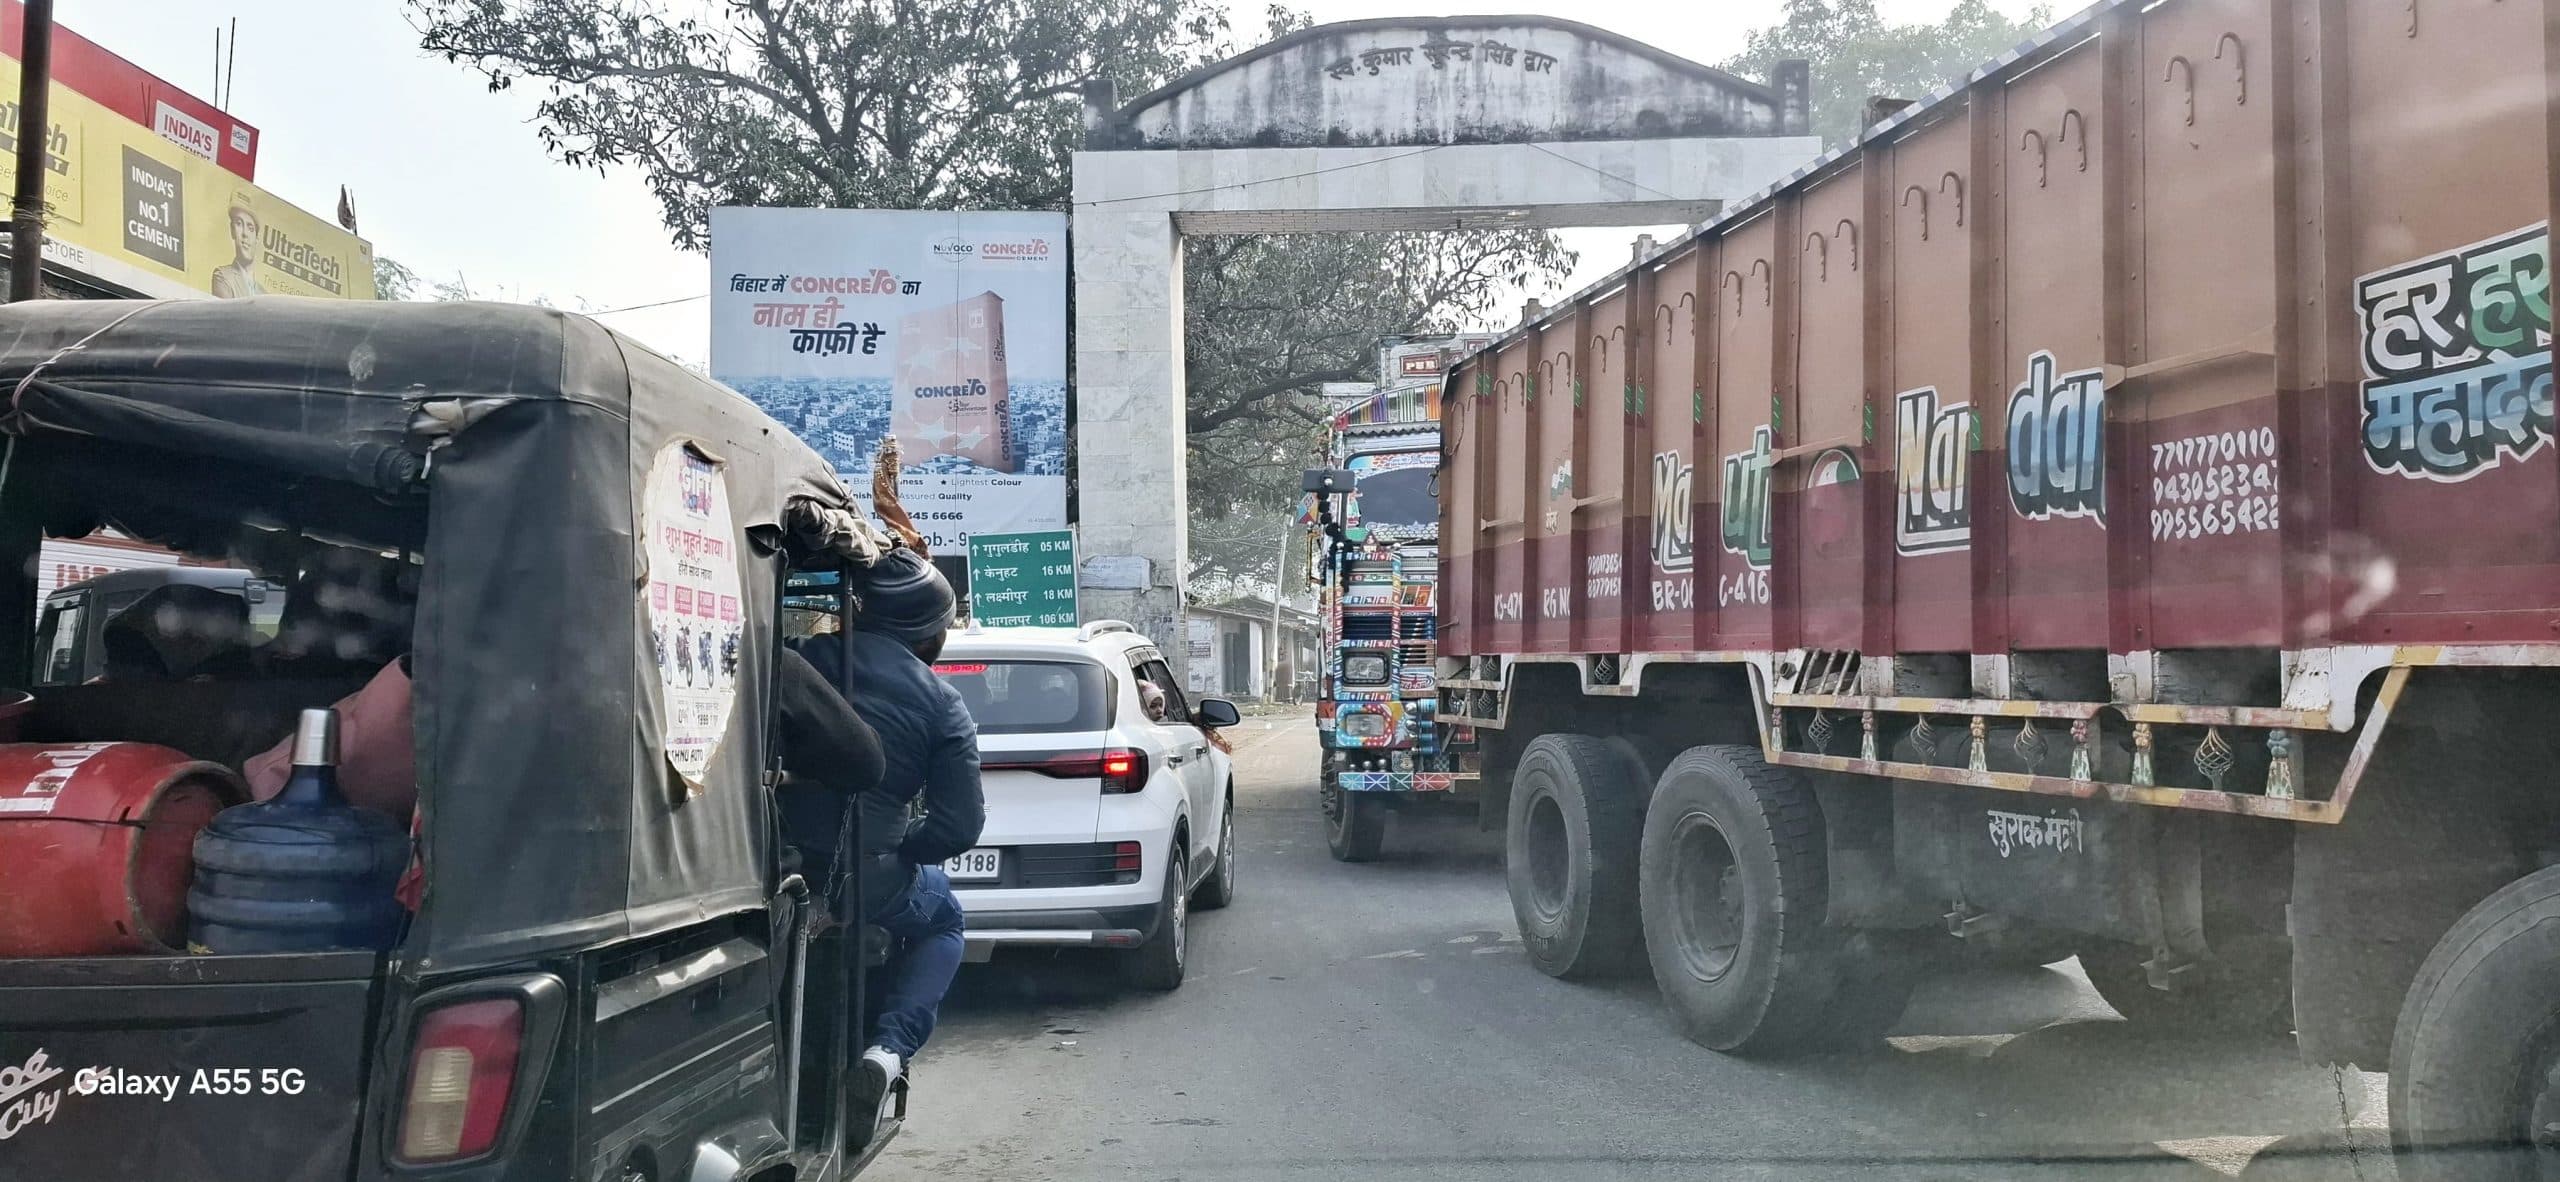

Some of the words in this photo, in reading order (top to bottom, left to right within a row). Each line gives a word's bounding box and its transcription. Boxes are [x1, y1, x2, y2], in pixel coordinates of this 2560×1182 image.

[1359, 46, 1413, 76] कुमार
[1479, 39, 1518, 67] सिंह
[1524, 49, 1558, 75] द्वार
[164, 113, 212, 152] INDIA'S
[46, 185, 69, 201] oice
[131, 165, 174, 199] INDIA'S
[139, 199, 169, 227] NO.1
[128, 219, 180, 253] CEMENT
[982, 239, 1049, 255] CONCRETO
[46, 240, 84, 264] STORE
[263, 224, 340, 280] UltraTech
[266, 253, 338, 292] CEMENT
[730, 273, 770, 293] बिहार
[771, 273, 789, 293] में
[790, 269, 897, 295] CONCRETO
[902, 280, 922, 296] का
[753, 302, 810, 329] नाम
[812, 296, 845, 329] ही
[2364, 263, 2454, 371] हर
[789, 321, 859, 357] काफ़ी
[862, 321, 887, 355] है
[914, 378, 987, 398] CONCRETO
[994, 399, 1010, 461] CONCRETO
[2151, 426, 2275, 473] 7717770110
[853, 492, 872, 501] nish
[938, 493, 972, 501] Quality
[951, 478, 988, 488] Lightest
[991, 478, 1022, 487] Colour
[932, 512, 963, 520] 6666
[665, 526, 681, 553] शुभ
[683, 529, 702, 560] मुहूर्त
[703, 536, 723, 558] आया
[1040, 541, 1053, 552] 05
[1055, 541, 1071, 551] KM
[984, 565, 1018, 581] केनुहट
[1042, 565, 1054, 577] 16
[1056, 564, 1072, 575] KM
[985, 588, 1029, 605] लक्ष्मीपुर
[1044, 590, 1055, 601] 18
[1057, 588, 1073, 599] KM
[1719, 570, 1772, 608] C-416
[1058, 612, 1074, 623] KM
[951, 854, 996, 873] 9188
[0, 1089, 62, 1140] City
